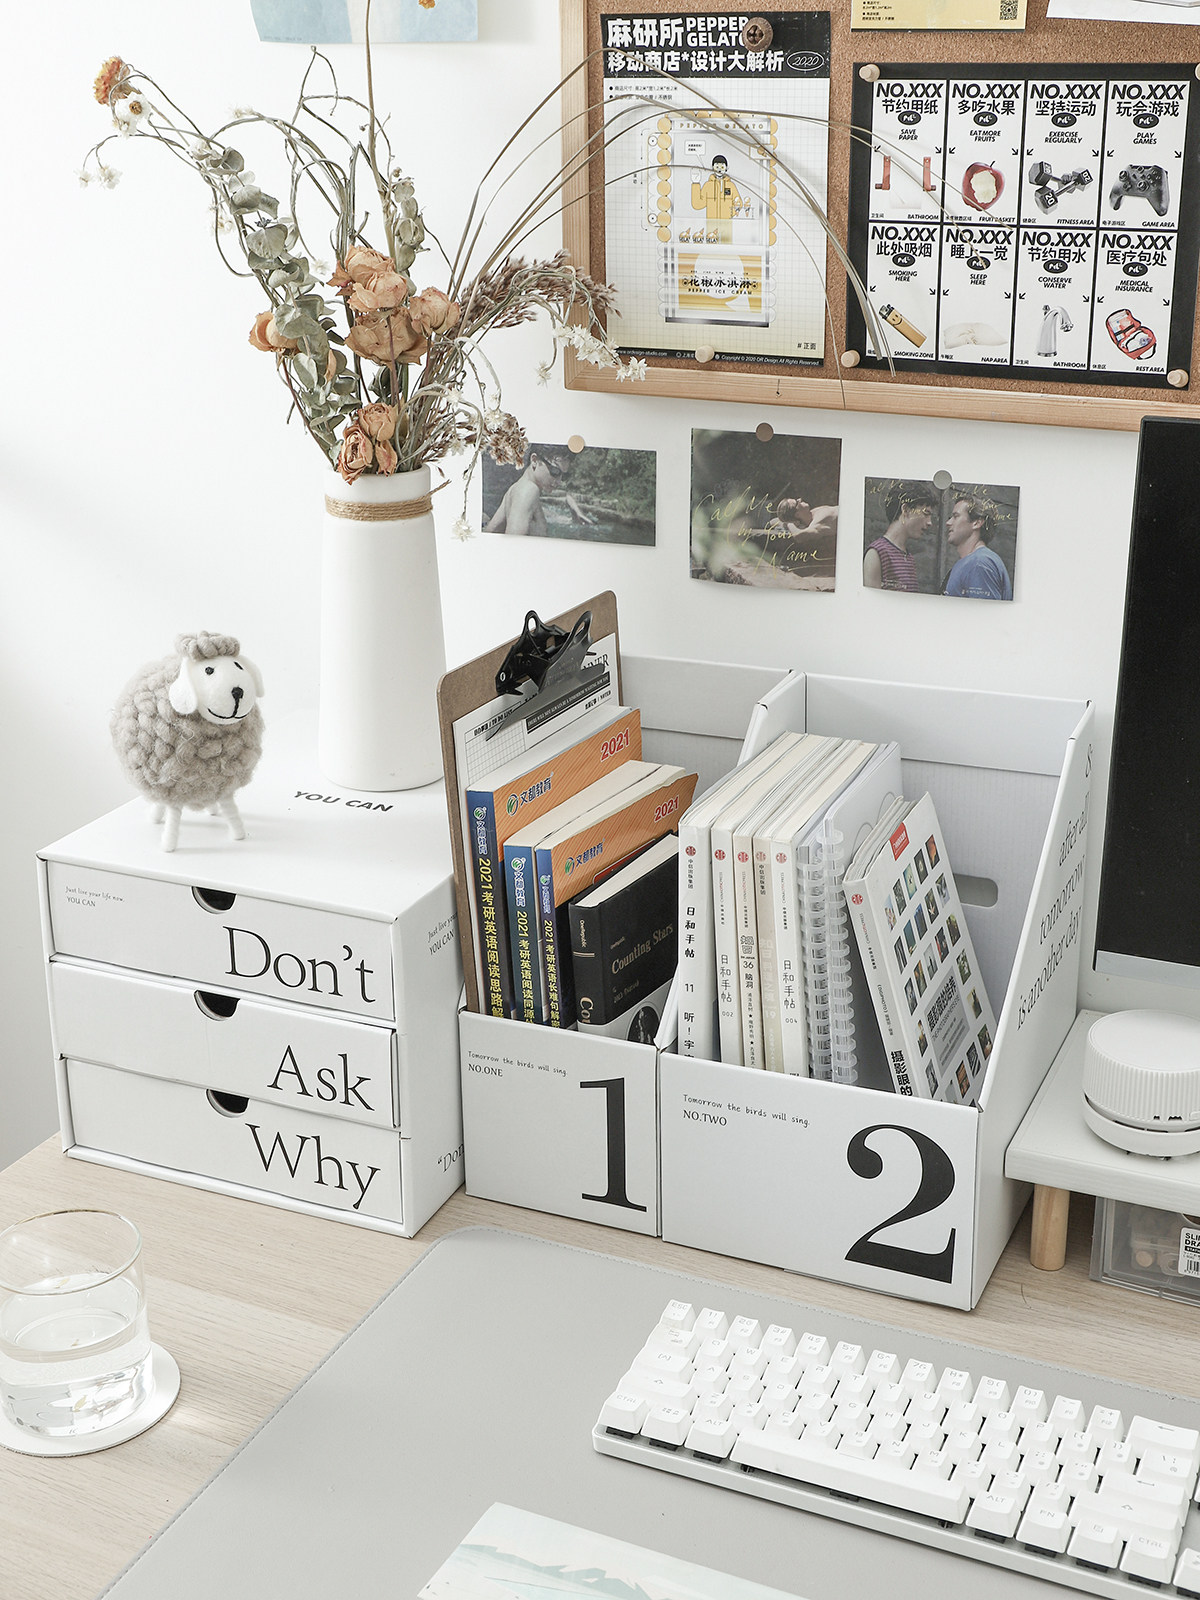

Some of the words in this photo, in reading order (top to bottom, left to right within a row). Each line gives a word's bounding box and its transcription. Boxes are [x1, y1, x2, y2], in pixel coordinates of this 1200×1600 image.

[607, 17, 684, 48] 麻研所
[792, 56, 818, 66] 2020
[876, 83, 944, 98] NO.XXX
[952, 83, 1022, 99] NO.XXX
[1030, 84, 1103, 100] NO.XXX
[1111, 84, 1187, 100] NO.XXX
[882, 98, 938, 115] 节约用纸
[957, 100, 1016, 115] 多吃水果
[1035, 101, 1096, 116] 坚持运动
[1116, 101, 1180, 117] 玩会游戏
[871, 226, 938, 242] NO.XXX
[945, 229, 1014, 245] NO.XXX
[1022, 231, 1093, 248] NO.XXX
[1101, 234, 1174, 251] NO.XXX
[876, 241, 932, 258] 此处吸烟
[1028, 247, 1087, 264] 节约用水
[1037, 276, 1072, 284] CONSERVE
[601, 728, 630, 761] 2021
[294, 791, 341, 804] YOU
[345, 800, 393, 812] CAN
[519, 776, 552, 808] 文都教育
[654, 796, 680, 822] 2021
[1059, 818, 1079, 868] after
[575, 841, 604, 869] 文都教育
[66, 896, 81, 905] YOU
[82, 899, 96, 908] CAN
[1040, 854, 1086, 946] tomorrow
[427, 926, 438, 943] Just
[438, 918, 447, 933] live
[685, 906, 696, 959] 日和手帖
[429, 938, 442, 955] YOU
[442, 929, 455, 946] CAN
[611, 939, 651, 975] Counting
[652, 922, 674, 946] Stars
[743, 960, 754, 969] 36
[1017, 995, 1027, 1031] is
[1027, 935, 1066, 1014] another
[1065, 905, 1083, 949] day
[720, 954, 732, 1003] 日和手帖
[782, 959, 795, 1009] 日和手帖
[722, 1010, 734, 1018] 002
[468, 1051, 500, 1062] Tomorrow
[503, 1057, 514, 1066] the
[517, 1060, 534, 1069] birds
[538, 1063, 550, 1072] will
[468, 1063, 504, 1078] NO.ONE
[267, 1045, 375, 1112] Ask
[683, 1094, 723, 1110] Tomorrow
[727, 1103, 741, 1113] the
[745, 1106, 767, 1118] birds
[772, 1110, 787, 1121] will
[683, 1109, 728, 1127] NO.TWO
[580, 1077, 647, 1213] 1
[245, 1122, 381, 1210] Why
[844, 1124, 957, 1285] 2
